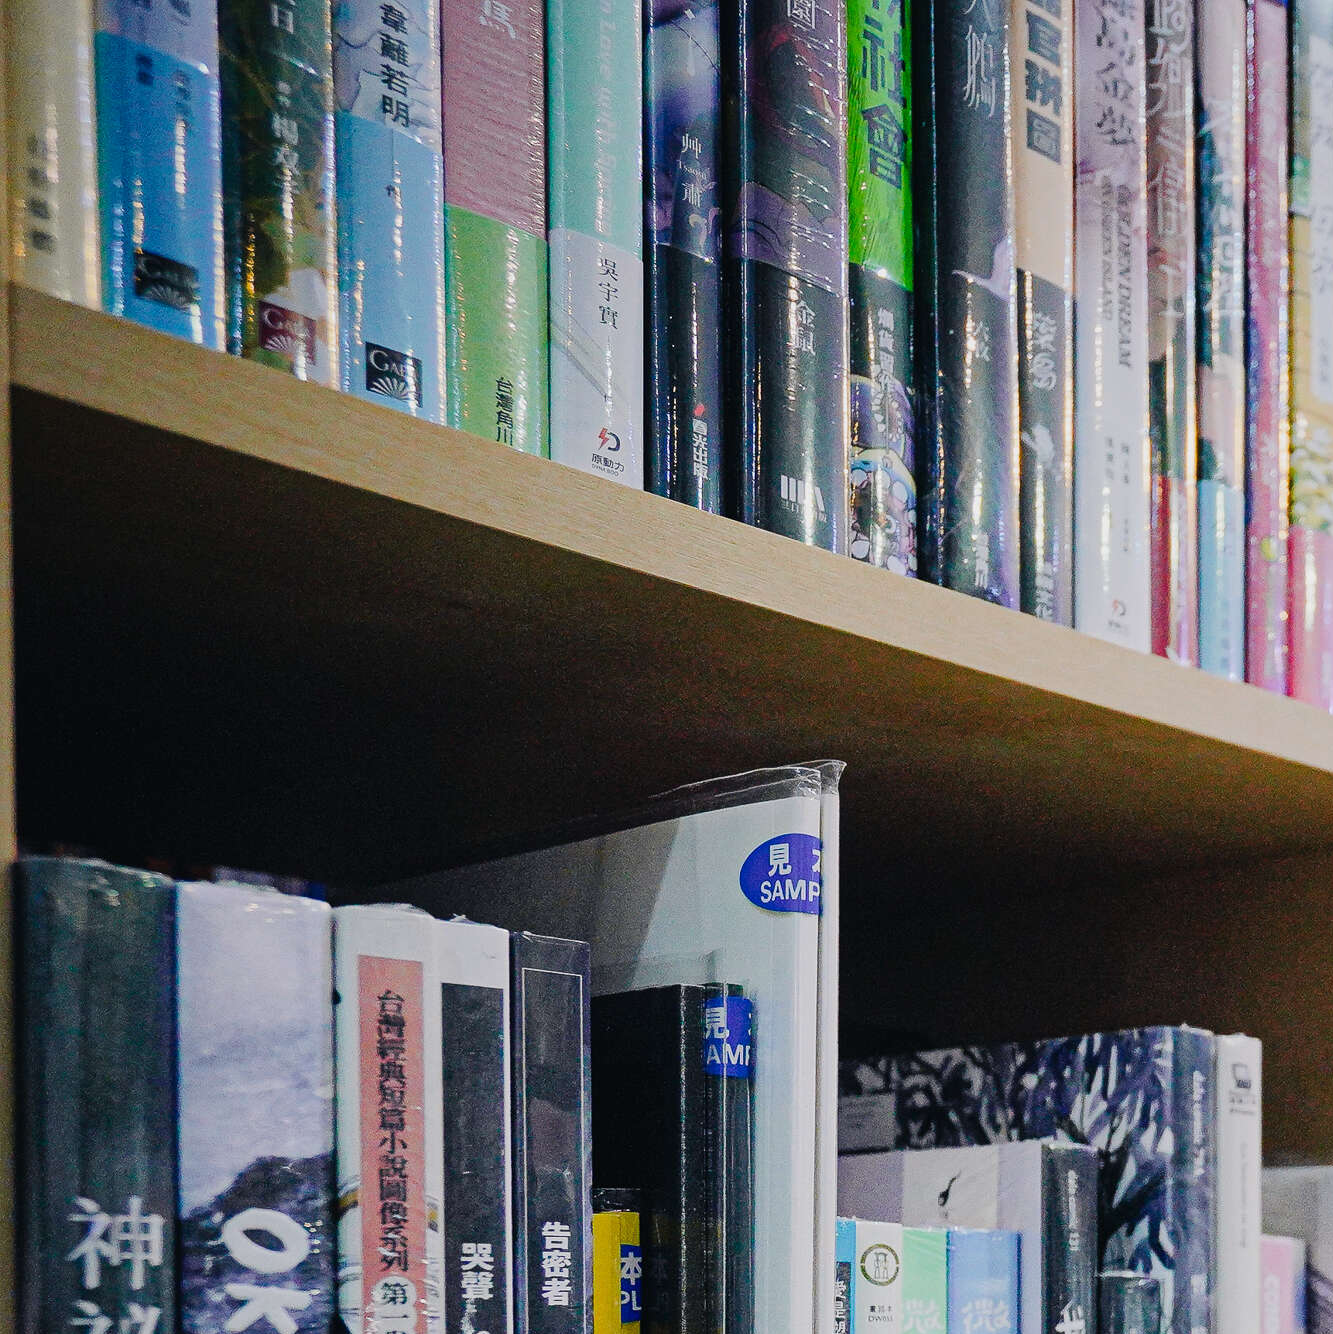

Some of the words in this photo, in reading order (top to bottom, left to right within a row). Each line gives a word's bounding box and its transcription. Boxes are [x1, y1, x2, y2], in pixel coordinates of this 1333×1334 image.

[460, 1243, 494, 1299] 哭聲
[542, 1222, 571, 1306] 告密者
[620, 1252, 642, 1285] 本
